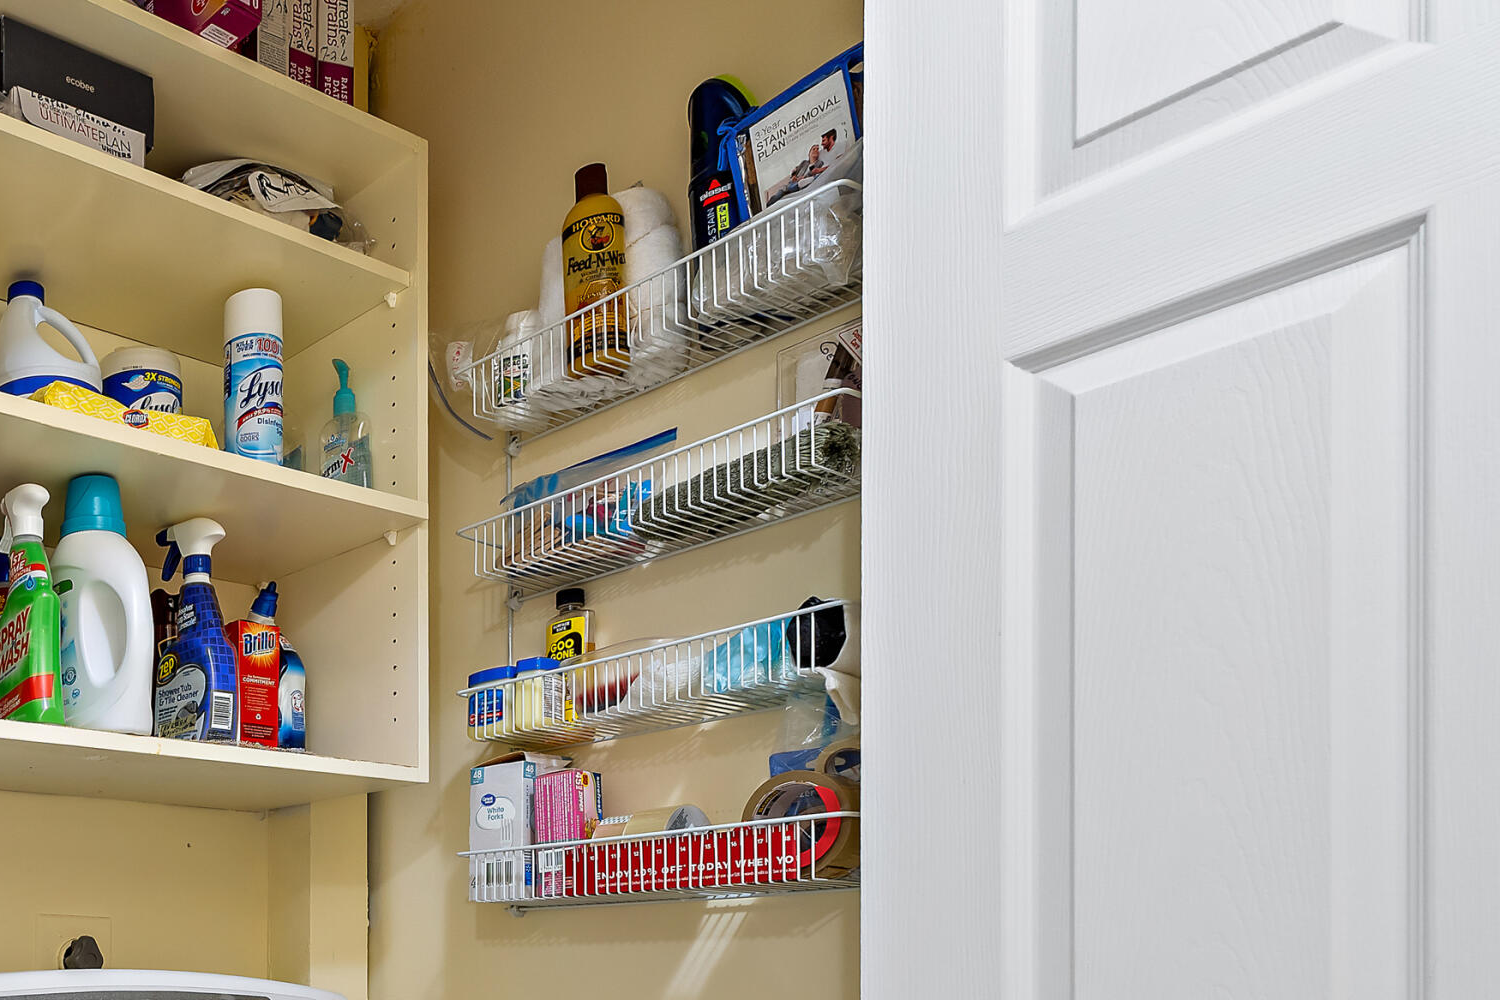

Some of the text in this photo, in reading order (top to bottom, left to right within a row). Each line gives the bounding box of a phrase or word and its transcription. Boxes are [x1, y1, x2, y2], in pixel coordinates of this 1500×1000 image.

[65, 75, 95, 93] ecobee
[754, 118, 783, 141] 3-Year
[756, 127, 787, 153] STAIN
[788, 94, 842, 132] REMOVAL
[101, 143, 132, 159] UNITERS
[757, 137, 787, 163] PLAN
[572, 214, 621, 233] HOWARD
[144, 371, 157, 382] 3X
[239, 371, 284, 410] Lysol
[123, 412, 148, 424] CLOROX
[242, 630, 277, 657] Brillo
[550, 638, 575, 653] GOO
[550, 648, 575, 661] GONE
[242, 676, 276, 687] COMMITMENT
[158, 682, 192, 699] Shower Tub
[176, 688, 200, 702] Cleaner
[472, 769, 482, 779] 48
[525, 764, 535, 774] 48
[486, 806, 505, 815] White
[596, 869, 630, 881] ENJOY
[634, 867, 657, 878] 10%
[691, 860, 729, 873] TODAY
[735, 857, 770, 869] WHEN
